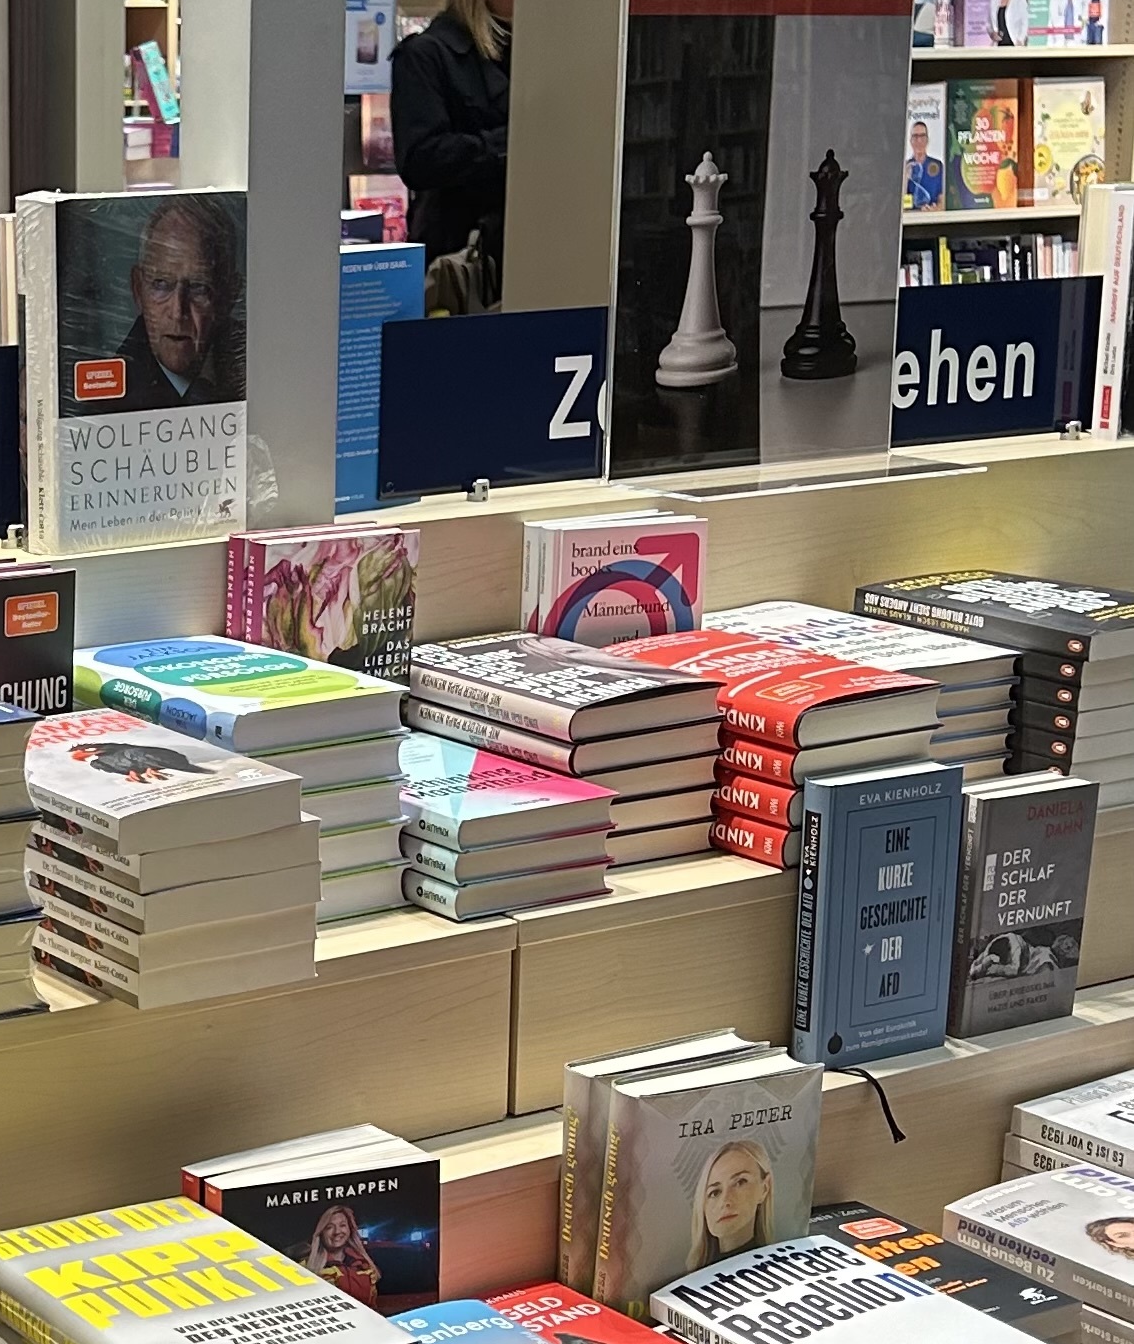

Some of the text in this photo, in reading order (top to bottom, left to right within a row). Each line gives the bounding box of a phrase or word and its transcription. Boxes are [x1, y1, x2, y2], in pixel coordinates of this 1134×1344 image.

[964, 151, 999, 165] WOCHE
[70, 413, 238, 452] WOLFGANG
[71, 445, 237, 485] SCHÄUBLE
[70, 477, 237, 511] ERINNERUNGEN
[571, 561, 611, 578] books
[361, 606, 413, 620] HELENE
[583, 599, 670, 619] Männerbund
[361, 619, 412, 634] BRACHT
[386, 639, 411, 653] DAS
[859, 783, 942, 805] EVA KIENHOLZ
[885, 827, 911, 854] EINE
[1002, 848, 1031, 867] DER
[877, 862, 915, 892] KURZE
[1001, 864, 1056, 886] SCHLAF
[998, 889, 1027, 907] DER
[859, 895, 928, 930] GESCHICHTE
[998, 901, 1072, 926] VERNUNFT
[880, 936, 902, 963] DER
[878, 971, 900, 999] AFD
[677, 1104, 795, 1138] IRA PETER
[266, 1177, 399, 1207] MARIE TRAPPEN
[121, 1195, 213, 1229] DIEZ
[25, 1232, 260, 1298] KIPP
[62, 1255, 318, 1330] PUNKTE
[669, 1245, 866, 1322] Autoritäre
